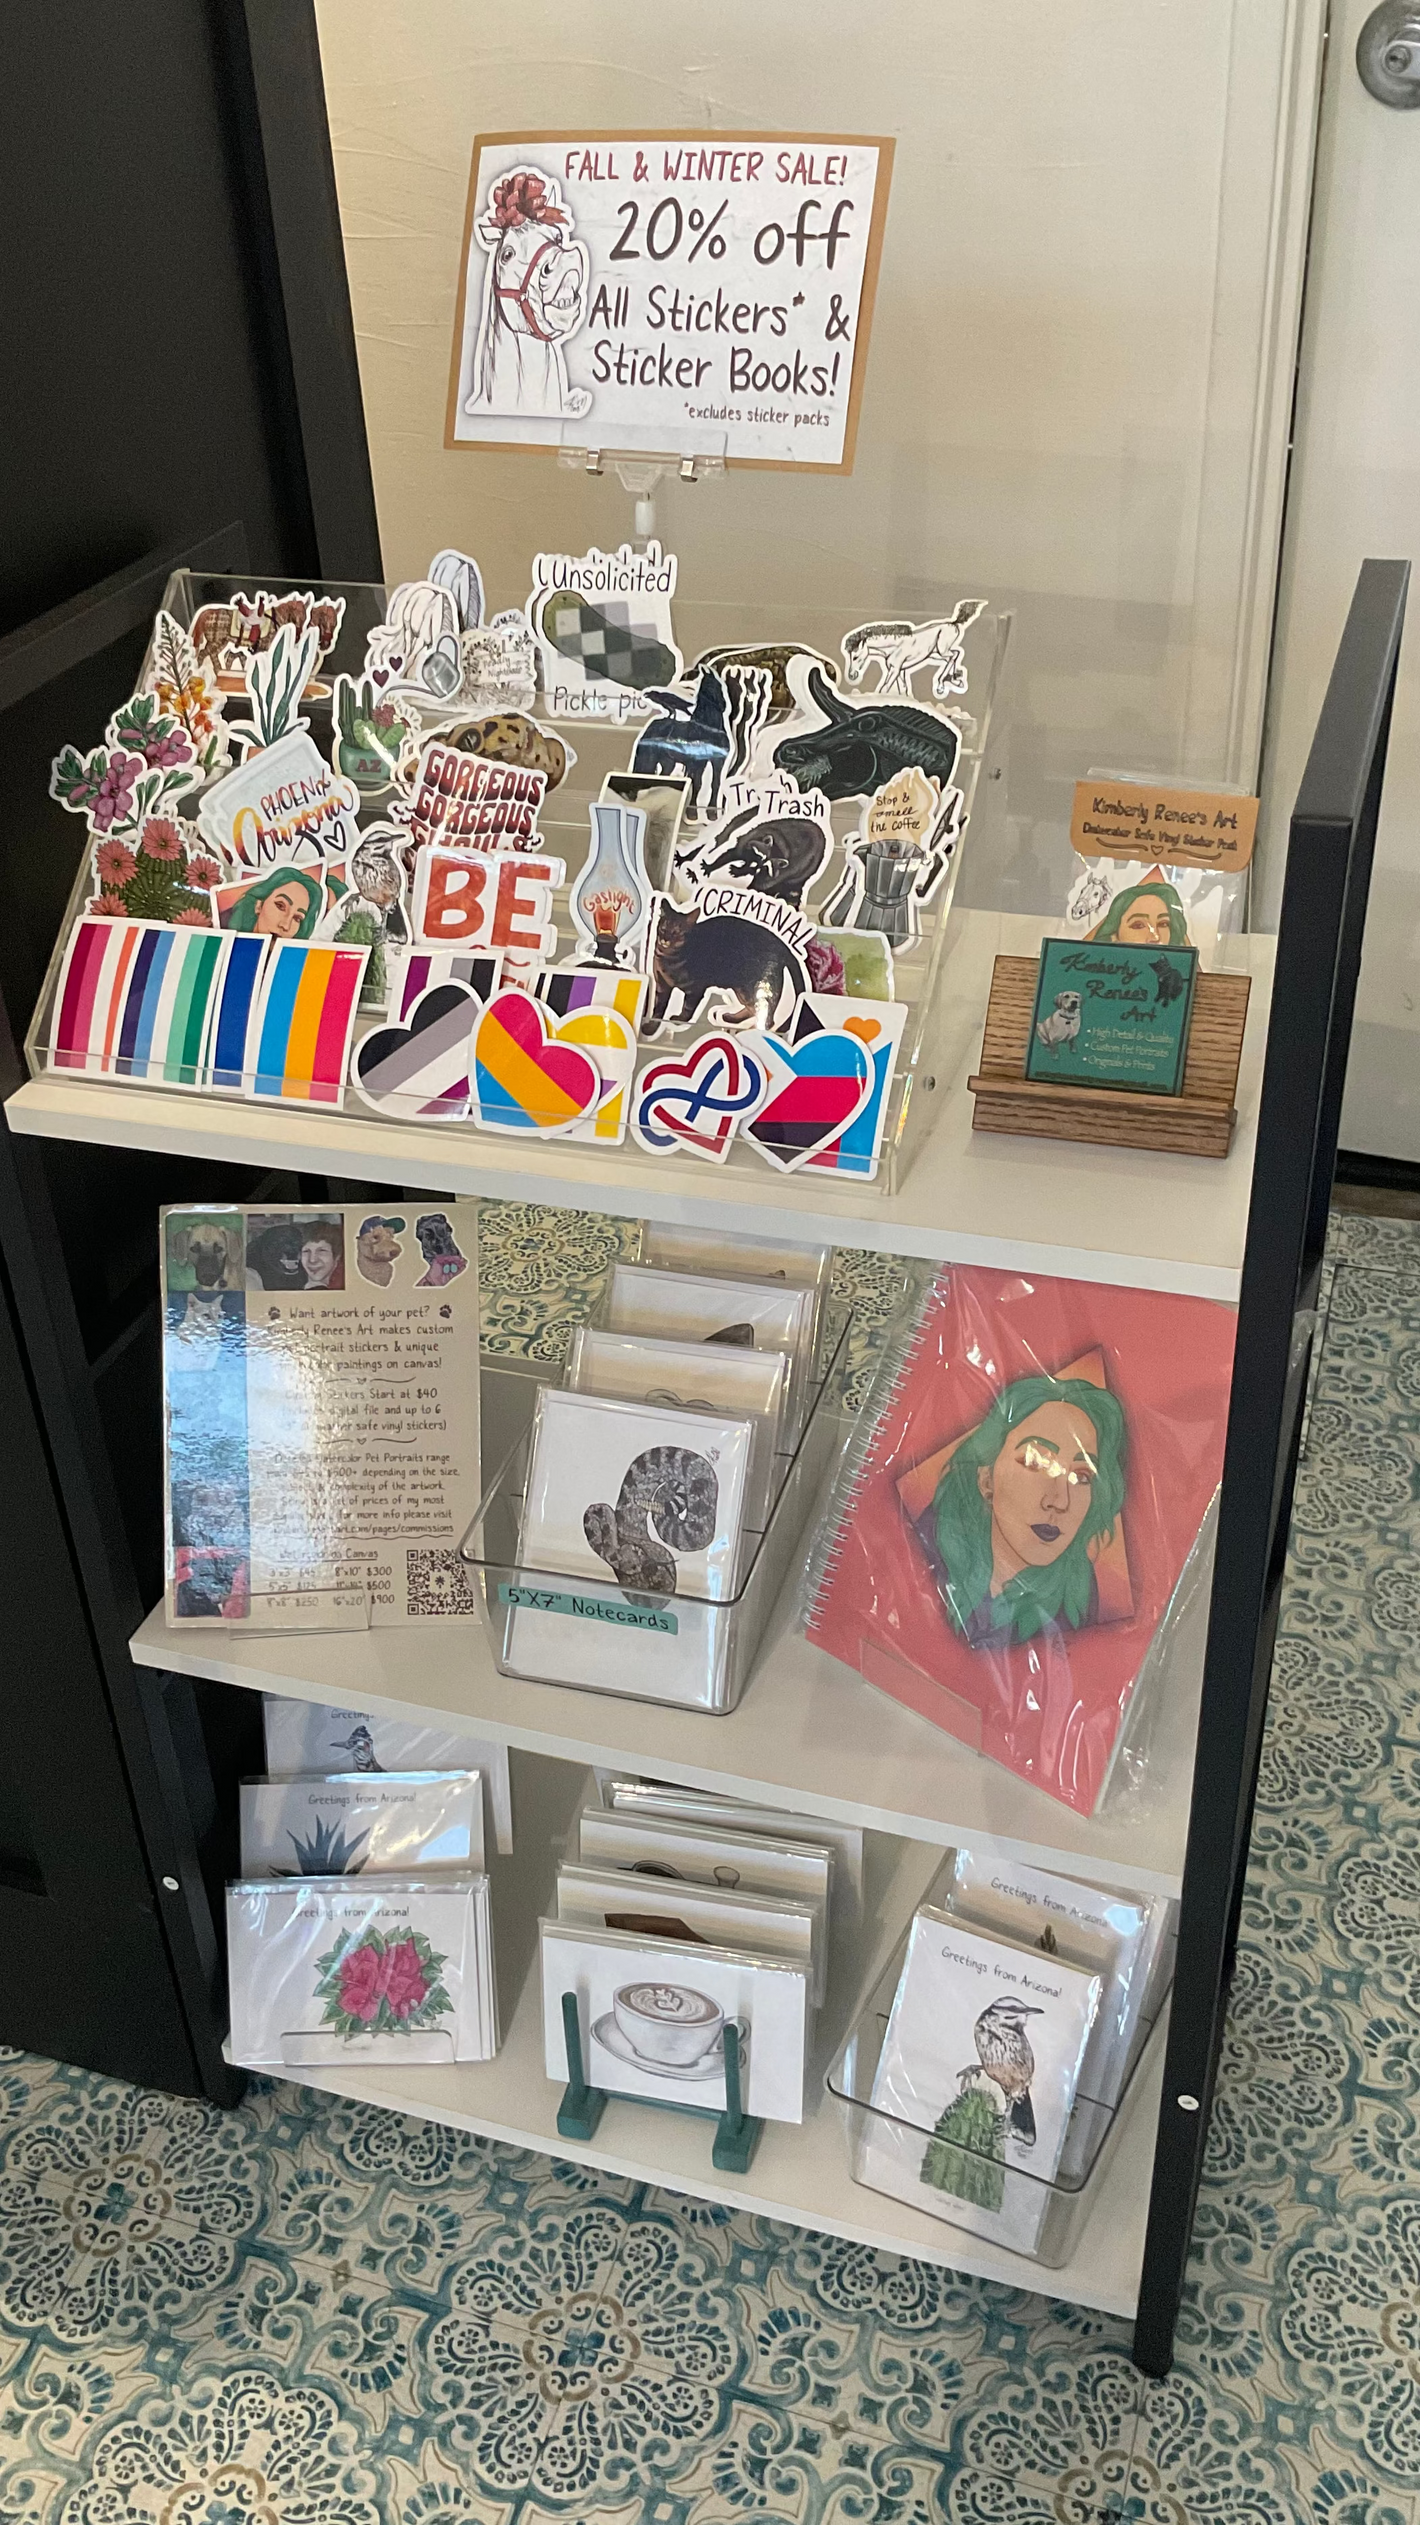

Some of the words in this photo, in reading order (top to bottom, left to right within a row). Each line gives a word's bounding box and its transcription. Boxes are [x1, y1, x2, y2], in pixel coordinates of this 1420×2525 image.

[564, 149, 619, 181] FALL
[632, 151, 649, 182] &
[663, 150, 764, 183] WINTER
[775, 152, 849, 186] SALE!
[609, 196, 729, 264] 20%
[753, 199, 855, 271] off
[588, 283, 630, 330] All
[824, 293, 851, 342] &
[592, 339, 713, 389] Sticker
[729, 346, 841, 398] Books!
[747, 405, 790, 426] sticker
[794, 410, 831, 428] packs
[553, 560, 672, 592] Unsolicited
[554, 685, 607, 711] Pickle
[355, 759, 382, 773] AZ
[424, 750, 544, 806] GORGEOUS
[765, 790, 825, 817] Trash
[876, 795, 898, 806] Stop
[902, 791, 910, 803] &
[415, 785, 535, 836] GORGEOUS
[872, 806, 919, 817] smell
[1093, 797, 1149, 824] Kimberly
[1154, 803, 1208, 825] Renee's
[1213, 810, 1238, 829] Art
[233, 784, 353, 867] Arizona
[871, 821, 887, 833] the
[892, 817, 921, 831] coffee
[423, 855, 551, 949] BE
[583, 889, 635, 915] Gaslight
[703, 888, 813, 956] CRIMINAL
[1060, 952, 1143, 985] Kimberly
[1086, 979, 1148, 1002] Renee's
[1120, 1005, 1157, 1023] Art
[289, 1307, 315, 1318] Want
[320, 1307, 360, 1318] artwork
[363, 1306, 376, 1318] of
[379, 1309, 402, 1321] your
[406, 1305, 430, 1319] pet?
[313, 1324, 352, 1335] Renee's
[357, 1323, 373, 1335] Art
[379, 1324, 411, 1335] makes
[416, 1325, 454, 1335] custom
[349, 1341, 389, 1352] stickers
[394, 1341, 402, 1353] &
[406, 1342, 439, 1355] unique
[337, 1358, 382, 1372] paintings
[386, 1361, 399, 1369] on
[404, 1357, 442, 1369] canvas!
[370, 1388, 395, 1399] Start
[400, 1390, 411, 1399] at
[416, 1387, 438, 1399] $40
[364, 1403, 380, 1415] file
[385, 1404, 401, 1415] and
[405, 1407, 417, 1416] up
[421, 1404, 432, 1414] to
[435, 1403, 442, 1415] 6
[356, 1420, 378, 1431] safe
[382, 1421, 404, 1434] vinyl
[407, 1421, 447, 1431] stickers)
[366, 1453, 380, 1462] Pet
[384, 1453, 424, 1462] Portraits
[426, 1455, 450, 1464] range
[362, 1468, 406, 1479] depending
[423, 1468, 436, 1476] the
[379, 1481, 388, 1491] of
[392, 1482, 406, 1491] the
[349, 1496, 359, 1505] of
[362, 1497, 389, 1507] prices
[392, 1496, 402, 1505] of
[407, 1498, 419, 1507] my
[423, 1497, 445, 1505] most
[383, 1510, 400, 1519] info
[403, 1510, 431, 1521] please
[433, 1509, 452, 1518] visit
[346, 1547, 379, 1559] Canvas
[366, 1566, 392, 1577] $300
[366, 1580, 391, 1591] $500
[370, 1594, 395, 1604] $900
[508, 1588, 562, 1608] 5"X7"
[572, 1597, 669, 1630] Notecards
[308, 1794, 350, 1807] Greetings
[355, 1793, 377, 1803] from
[380, 1792, 417, 1803] Arizona!
[991, 1876, 1037, 1905] Greetings
[1043, 1895, 1066, 1912] from
[344, 1906, 366, 1917] from
[370, 1906, 409, 1917] rizona!
[942, 1946, 988, 1974] Greetings
[994, 1964, 1017, 1982] from
[1021, 1975, 1063, 1998] Arizona!
